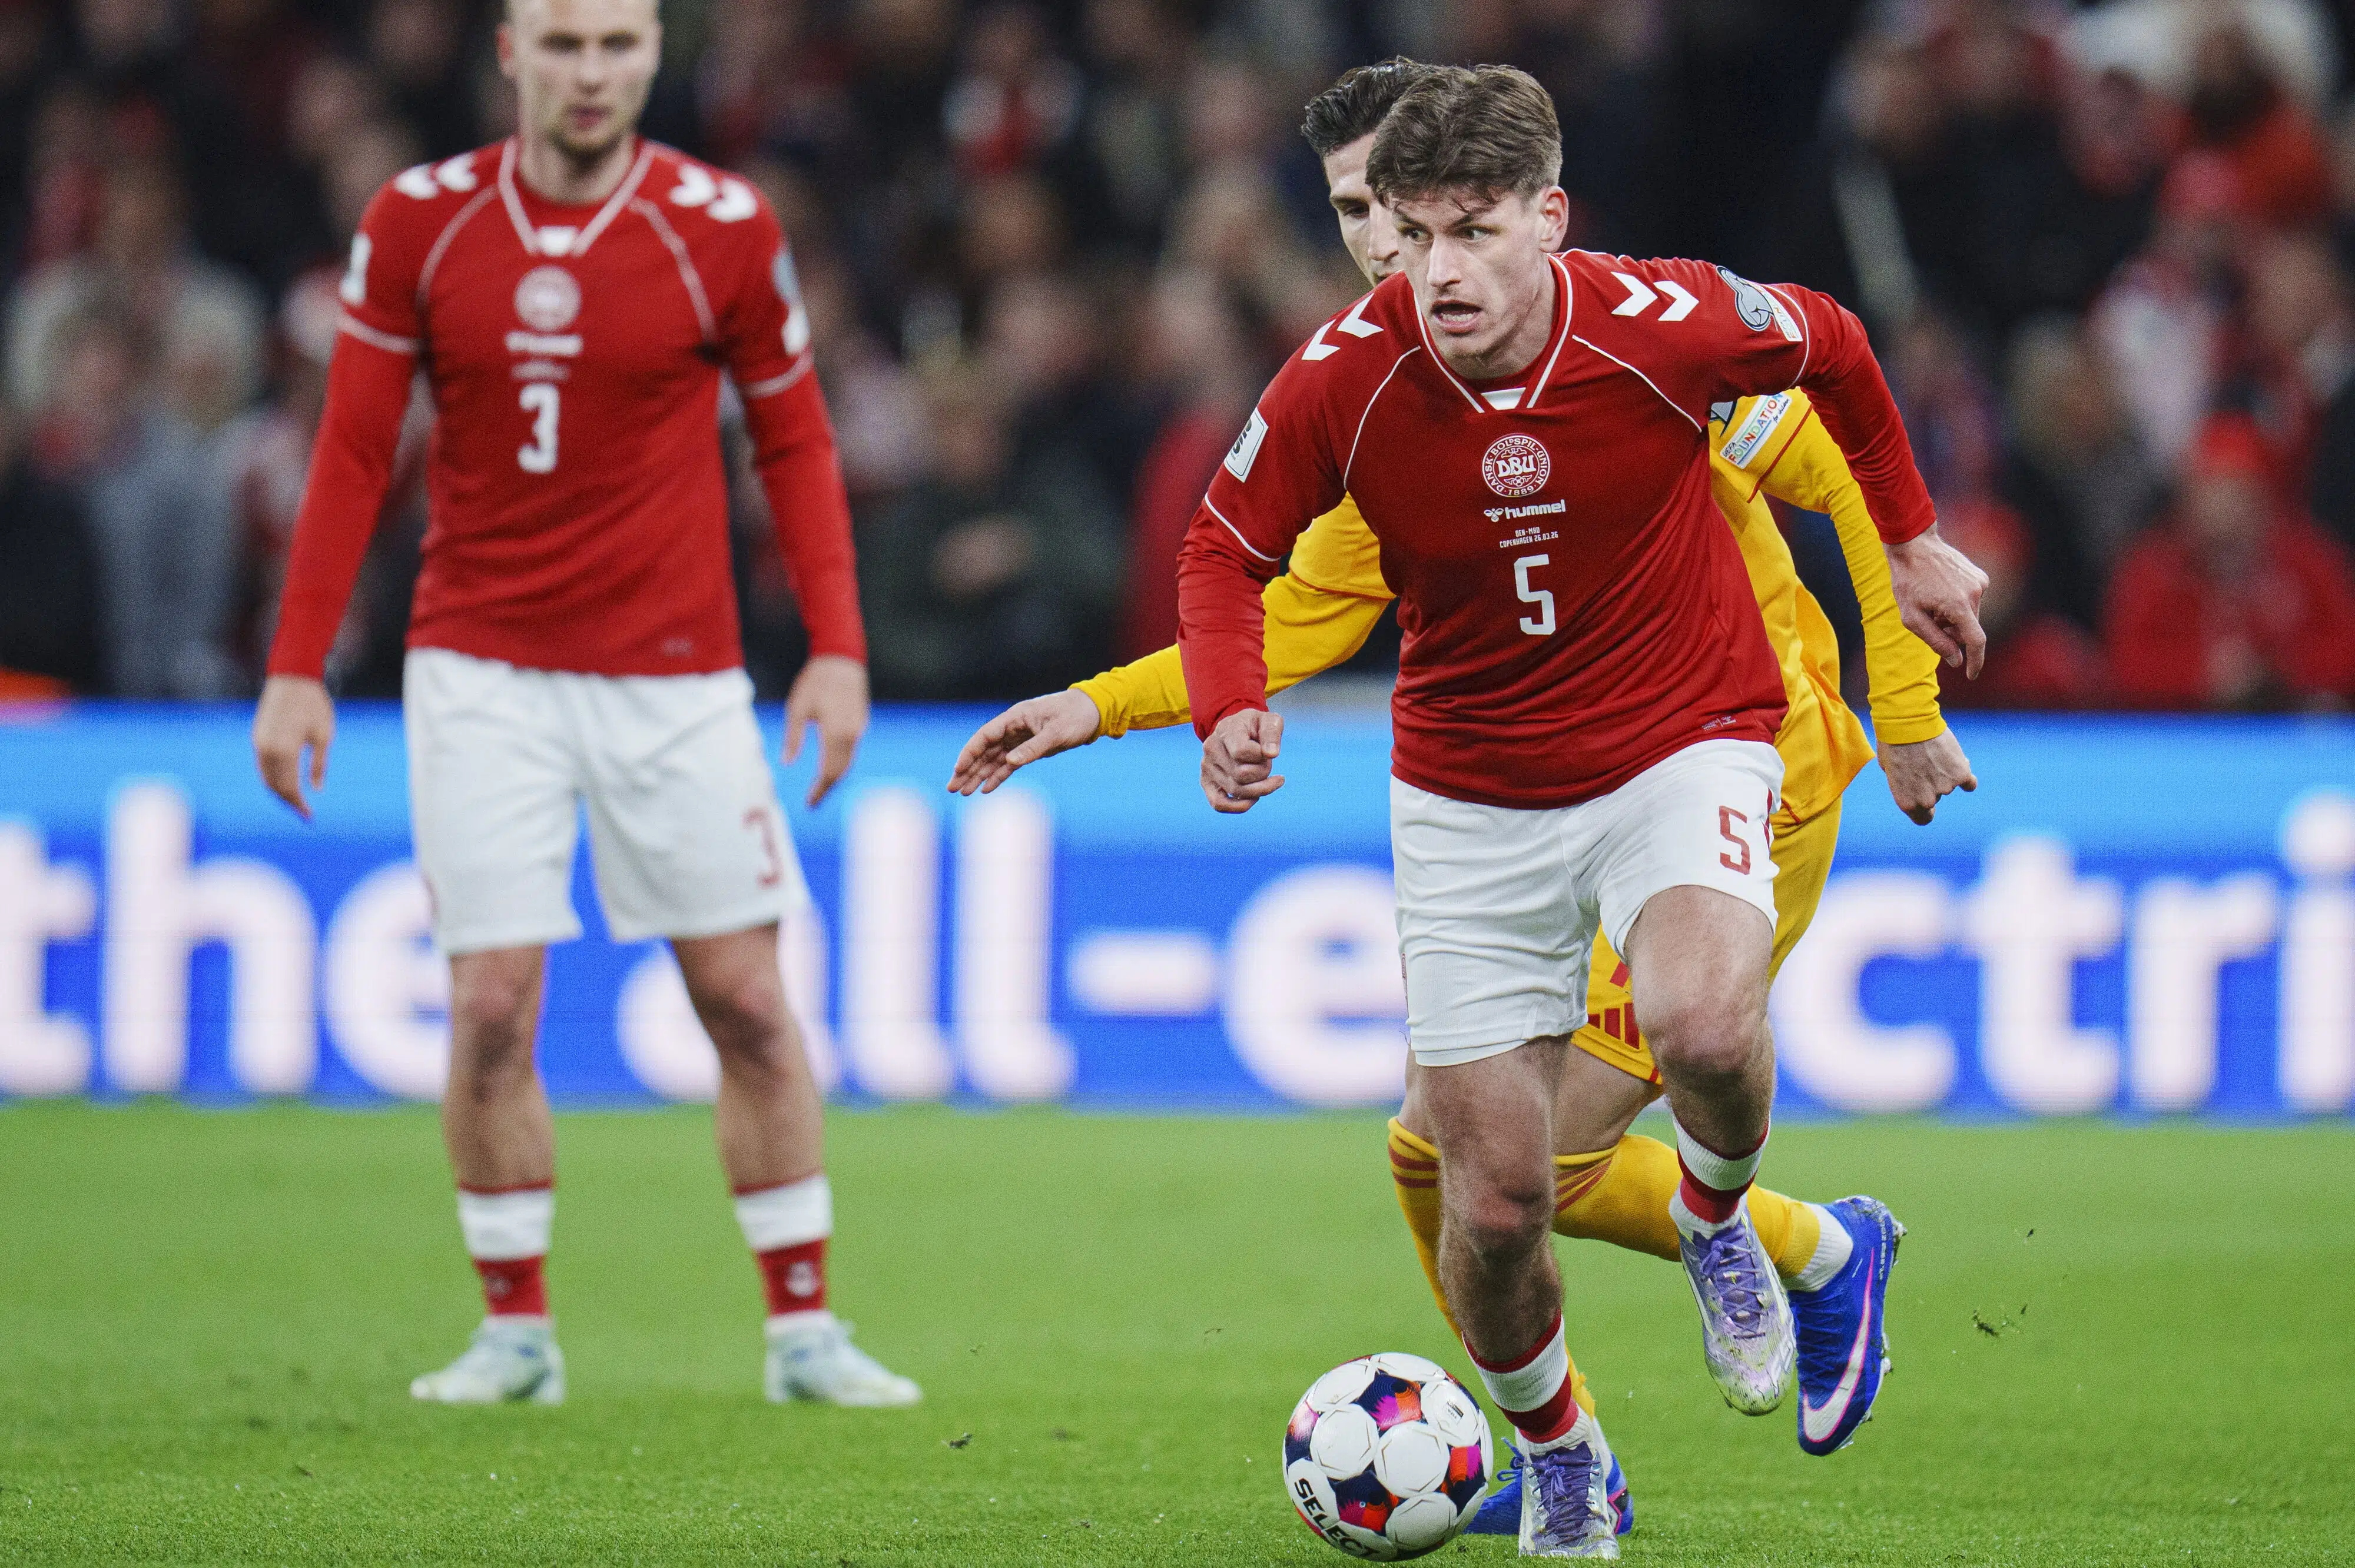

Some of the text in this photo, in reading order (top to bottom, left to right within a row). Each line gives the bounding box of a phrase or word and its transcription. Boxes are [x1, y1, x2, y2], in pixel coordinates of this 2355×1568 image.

[518, 383, 559, 473] 3
[1729, 393, 1783, 463] FOUNDATION
[1496, 455, 1537, 477] DBU
[1722, 441, 1737, 457] UEFA
[1485, 457, 1505, 493] DANSK
[1508, 486, 1534, 496] 1889
[1505, 499, 1566, 519] hummel
[1499, 531, 1559, 548] COPENHAGEN 26.03.26
[1514, 554, 1556, 635] 5
[742, 806, 784, 890] 3
[1719, 805, 1751, 875] 5
